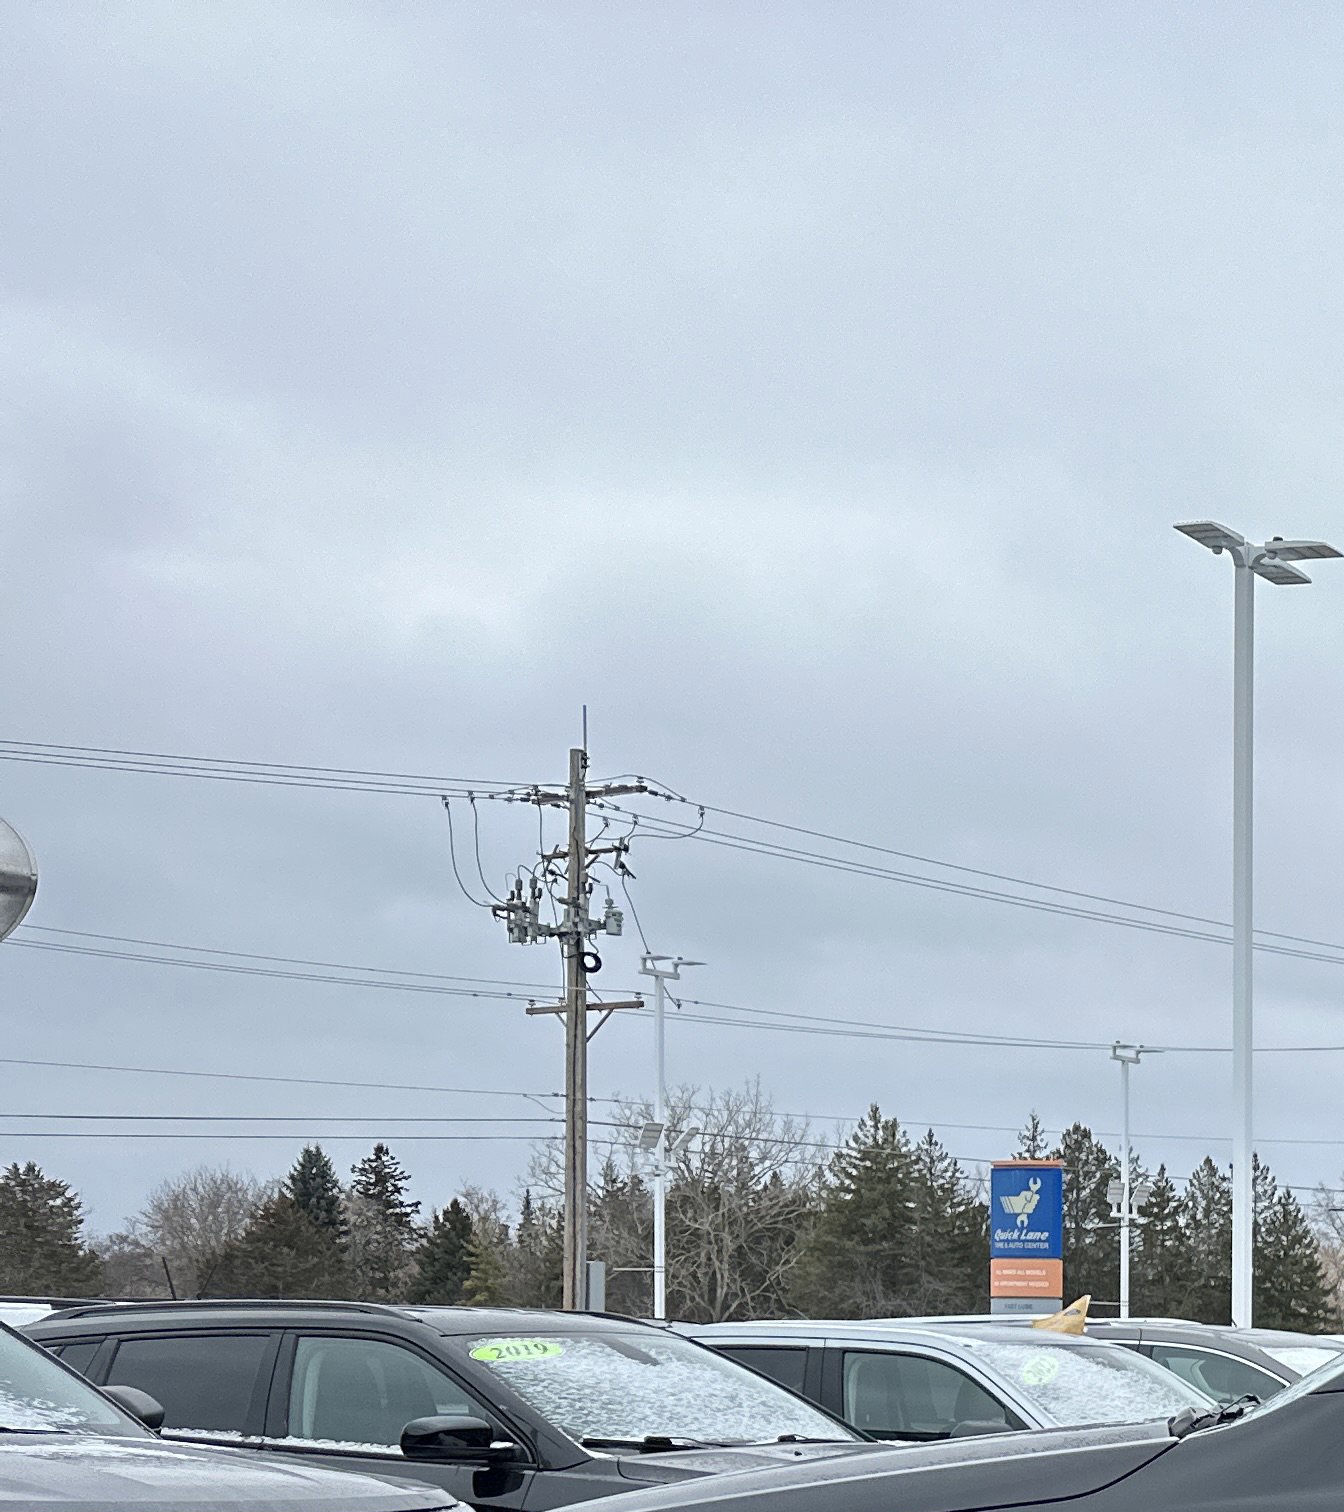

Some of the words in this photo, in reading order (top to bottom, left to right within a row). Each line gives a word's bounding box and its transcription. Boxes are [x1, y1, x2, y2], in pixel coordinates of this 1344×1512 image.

[994, 1229, 1020, 1241] Quick
[1020, 1229, 1049, 1240] Lane
[489, 1343, 549, 1359] 2019
